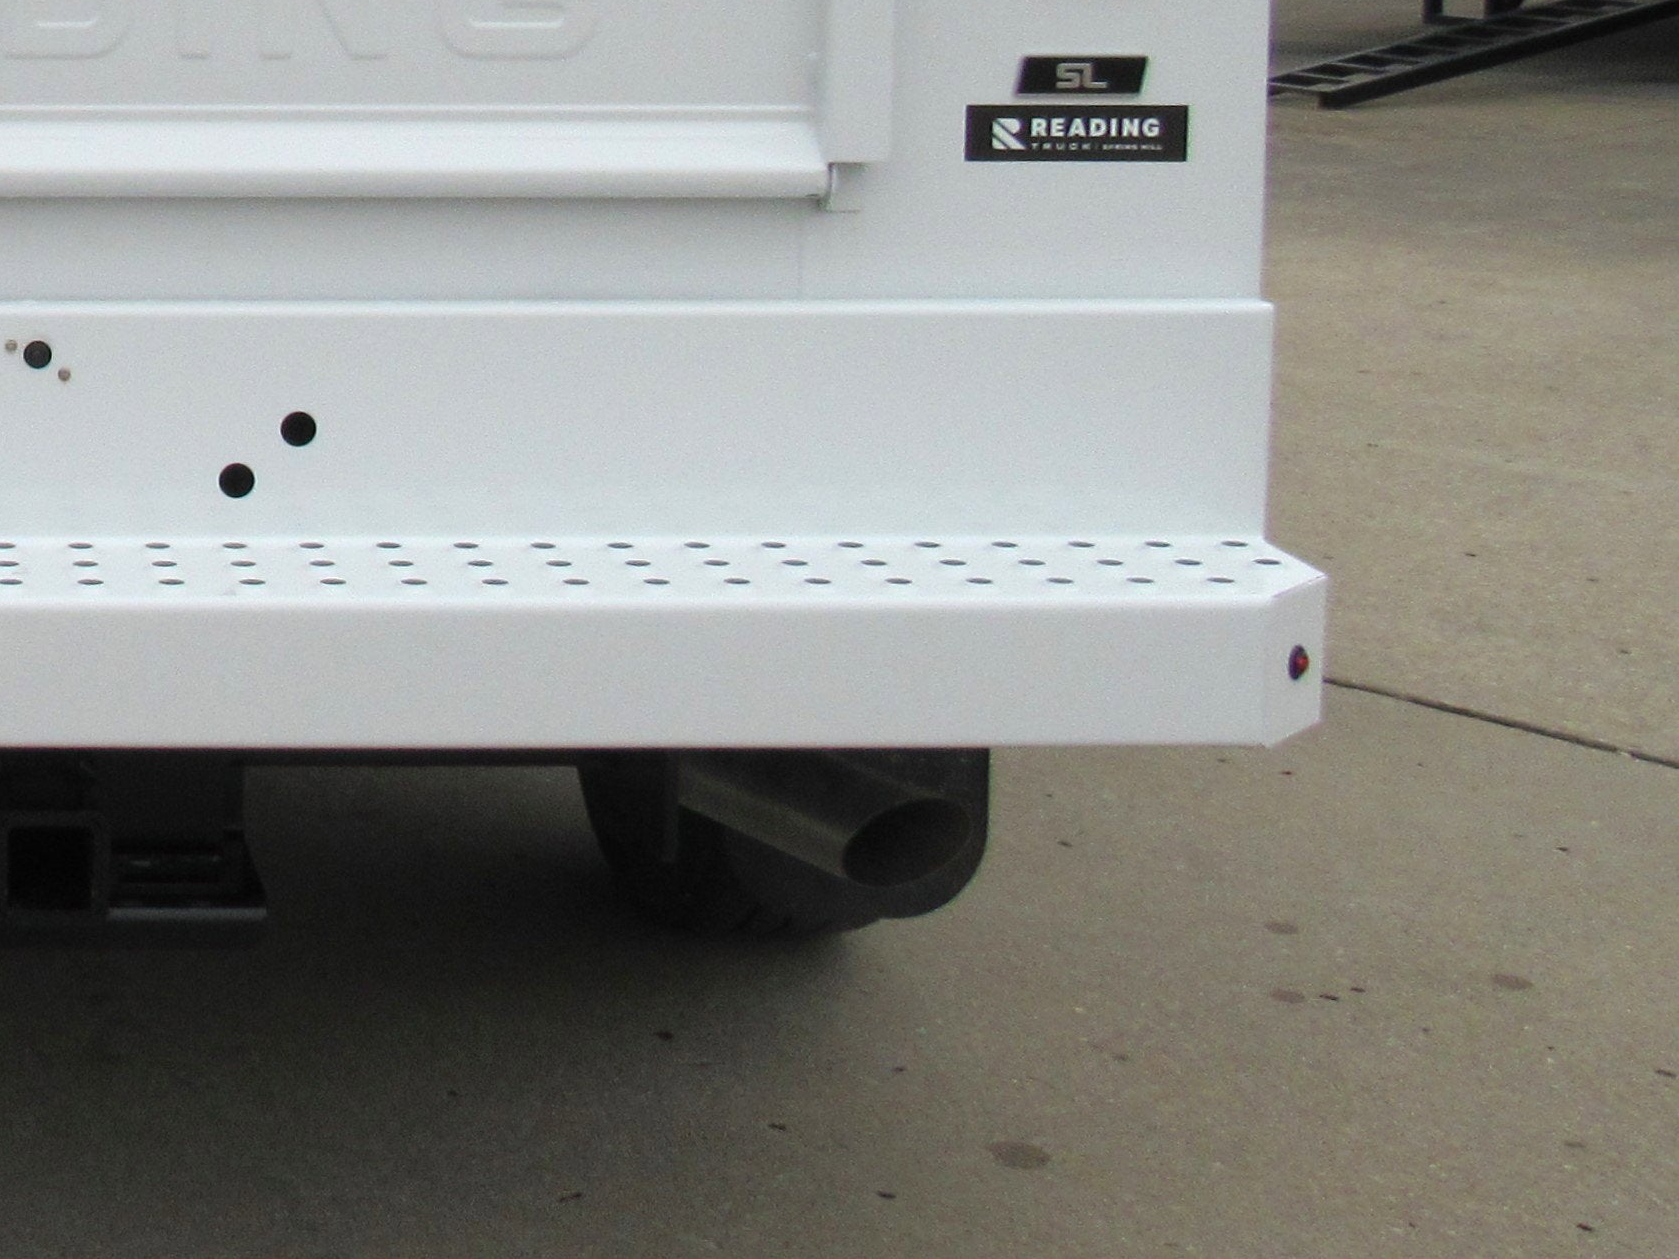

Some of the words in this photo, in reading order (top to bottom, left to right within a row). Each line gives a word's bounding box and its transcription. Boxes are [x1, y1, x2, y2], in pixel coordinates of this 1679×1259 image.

[1055, 62, 1108, 89] SL
[1030, 117, 1161, 138] READING
[1031, 142, 1091, 151] TRUCK
